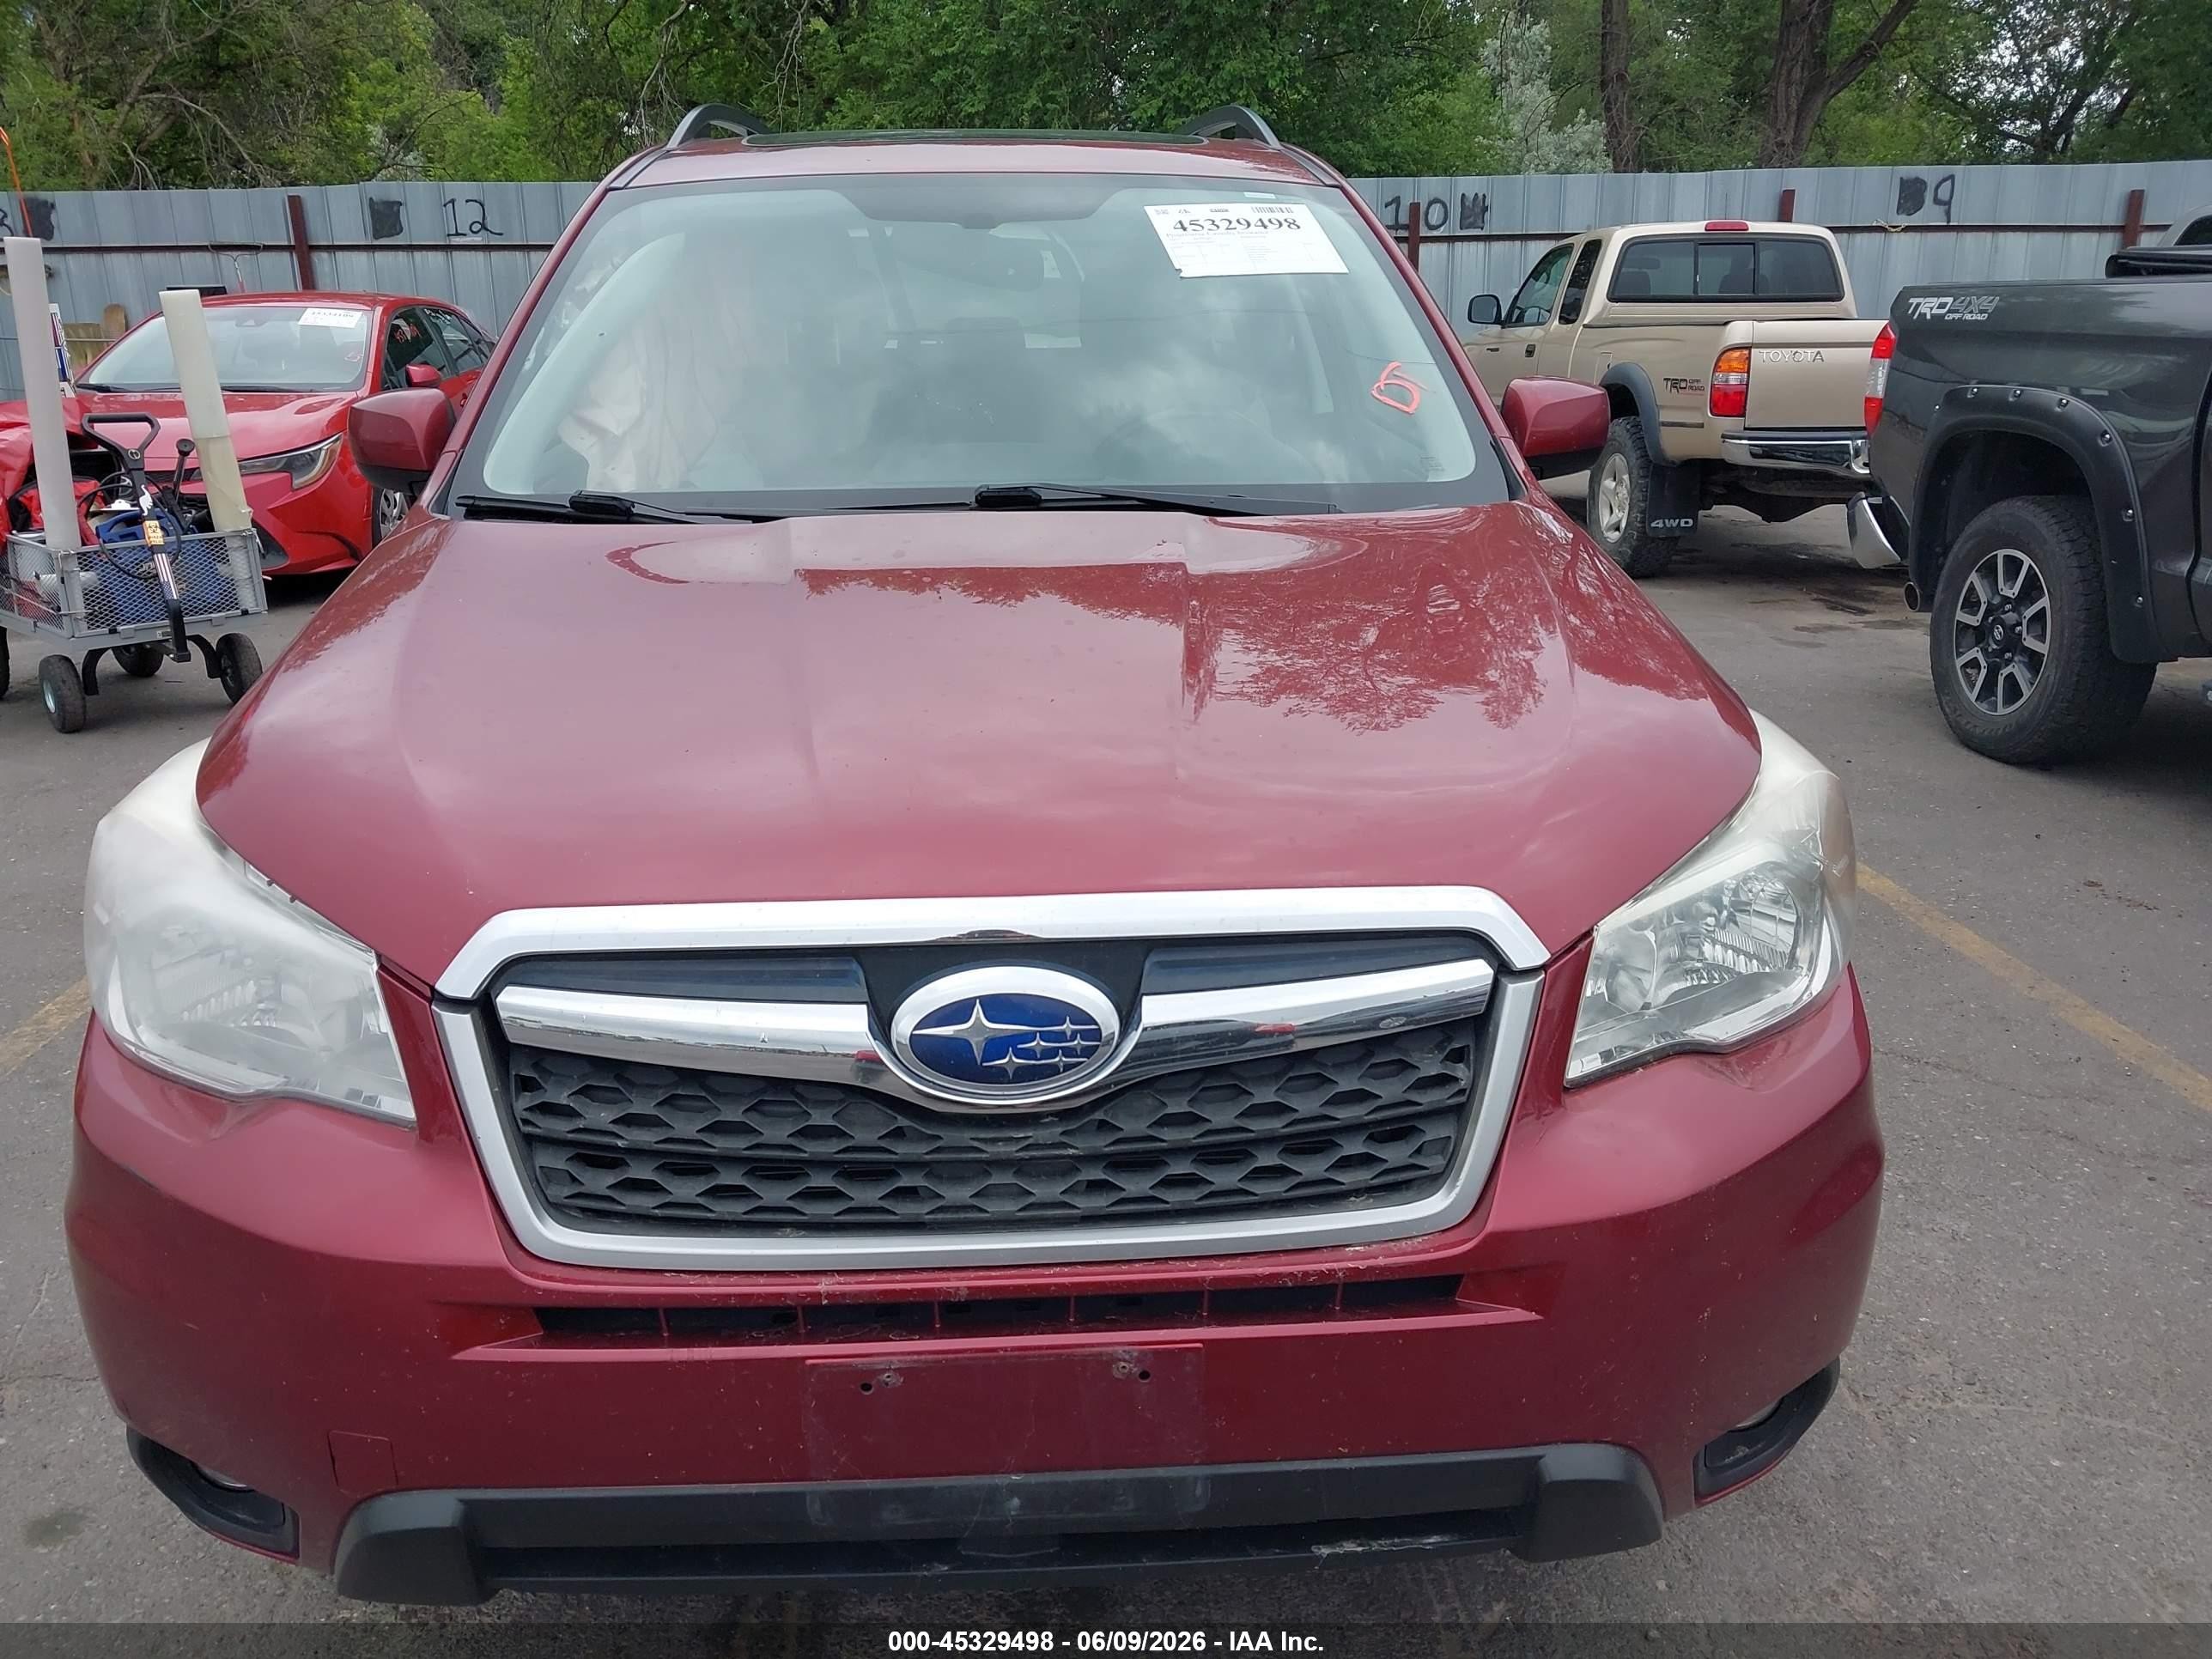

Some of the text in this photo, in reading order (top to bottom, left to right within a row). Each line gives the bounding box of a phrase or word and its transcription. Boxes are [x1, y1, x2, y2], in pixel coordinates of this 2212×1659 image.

[443, 198, 503, 236] 12
[1384, 195, 1449, 232] 10
[1173, 217, 1301, 232] 45329498
[1908, 297, 1954, 319] TRD
[1759, 349, 1825, 363] TOYOTA
[1662, 378, 1688, 393] TRD
[1650, 518, 1693, 528] 4WD
